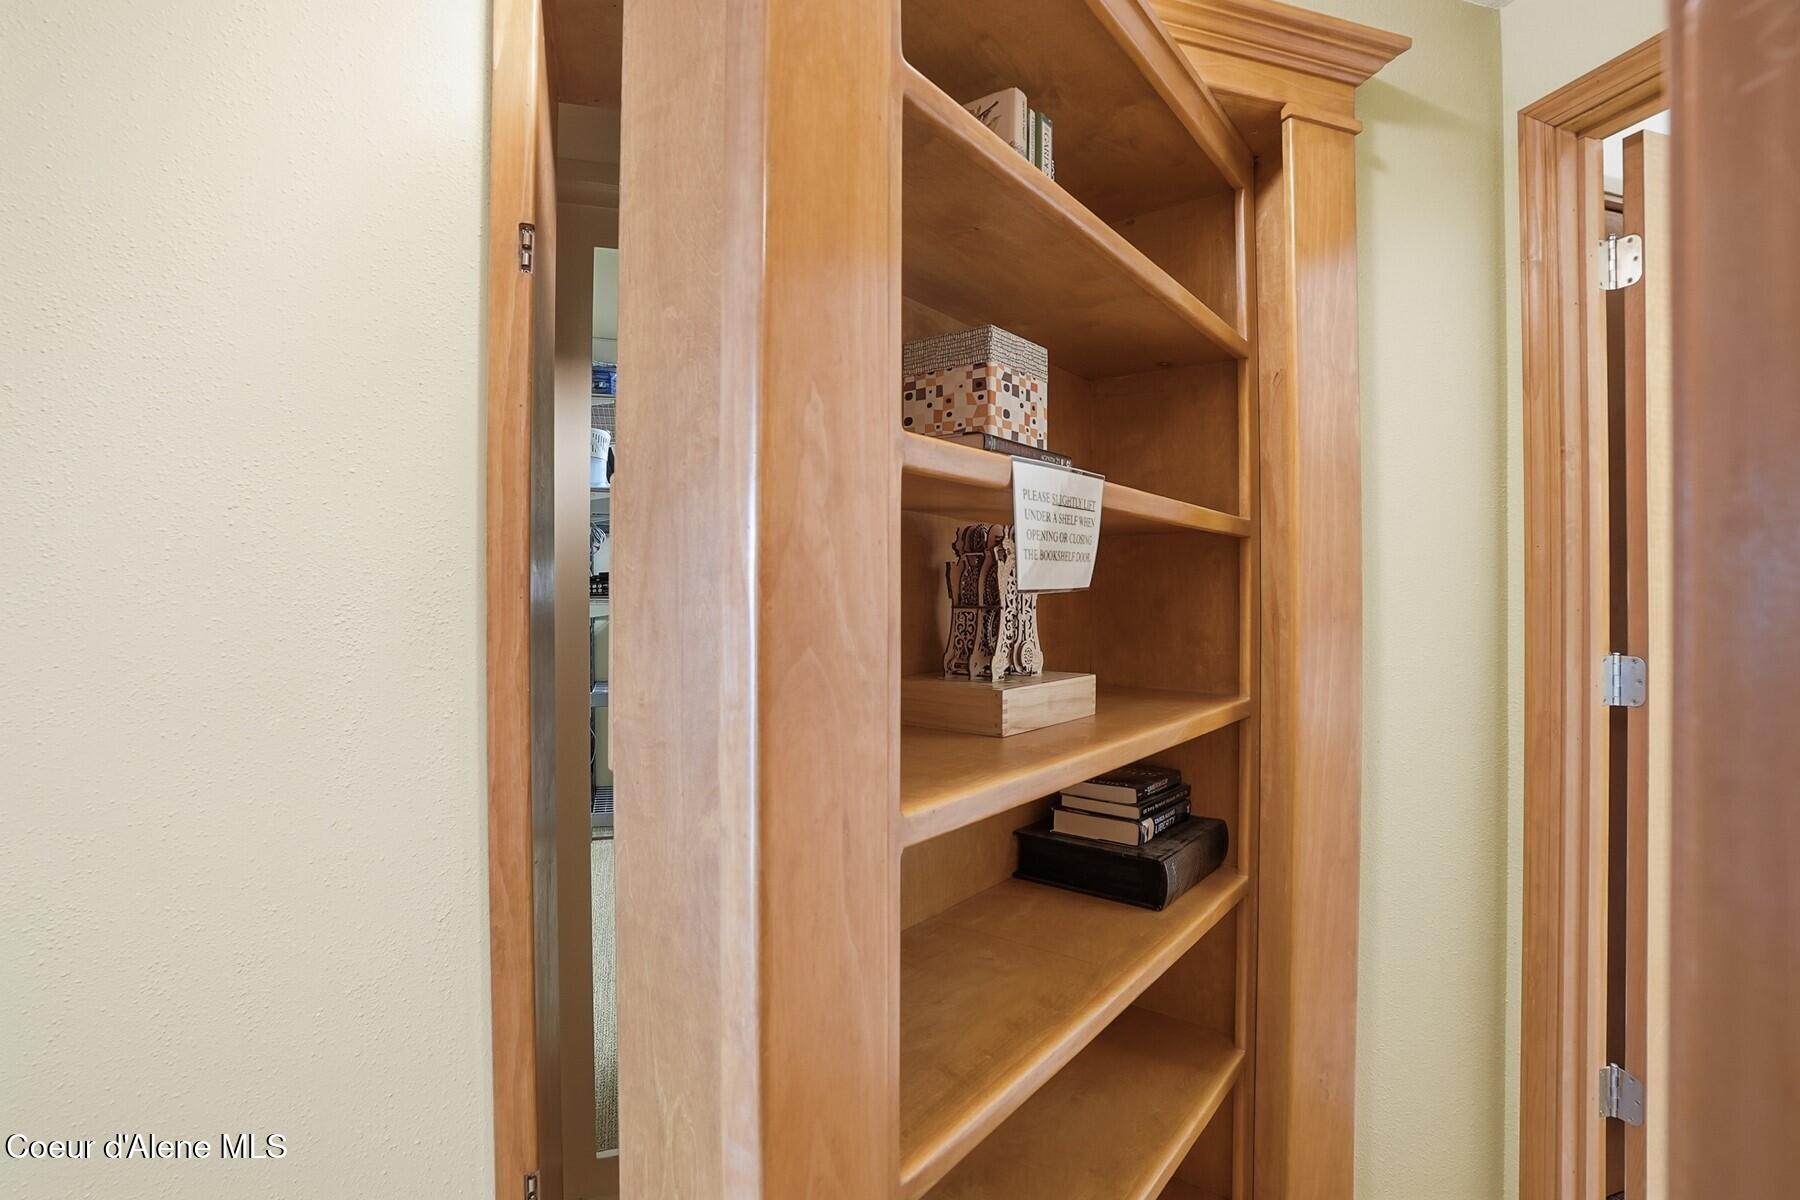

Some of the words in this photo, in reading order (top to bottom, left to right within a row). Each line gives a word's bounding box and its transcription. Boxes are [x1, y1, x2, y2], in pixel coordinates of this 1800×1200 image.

[1022, 488, 1050, 503] PLEASE
[1052, 493, 1083, 509] SLIGHTLY
[1083, 498, 1096, 510] LIFT
[1024, 508, 1051, 523] UNDER
[1052, 513, 1058, 524] A
[1058, 513, 1078, 525] SHELF
[1078, 516, 1096, 527] WHEN
[1026, 528, 1059, 543] OPENING
[1059, 531, 1068, 543] OR
[1069, 533, 1093, 545] CLOSING
[1024, 548, 1039, 560] THE
[1039, 549, 1075, 562] BOOKSHELF
